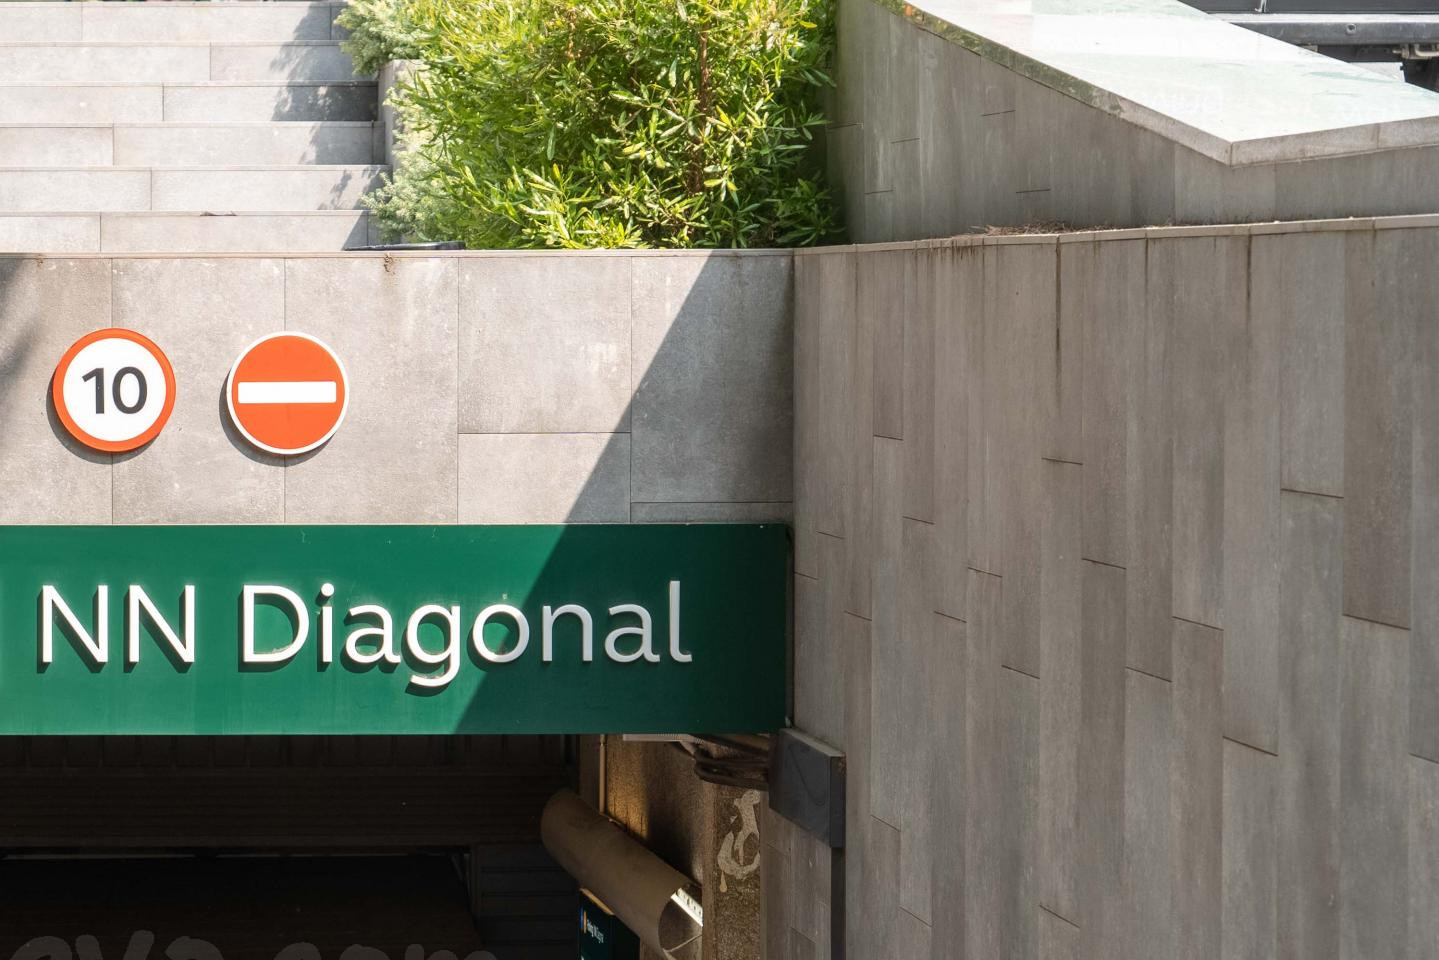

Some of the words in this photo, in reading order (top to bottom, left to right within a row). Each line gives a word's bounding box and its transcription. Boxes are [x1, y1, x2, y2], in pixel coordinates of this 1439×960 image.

[82, 366, 148, 414] 10
[42, 584, 196, 662] NN
[243, 580, 693, 688] Diagonal
